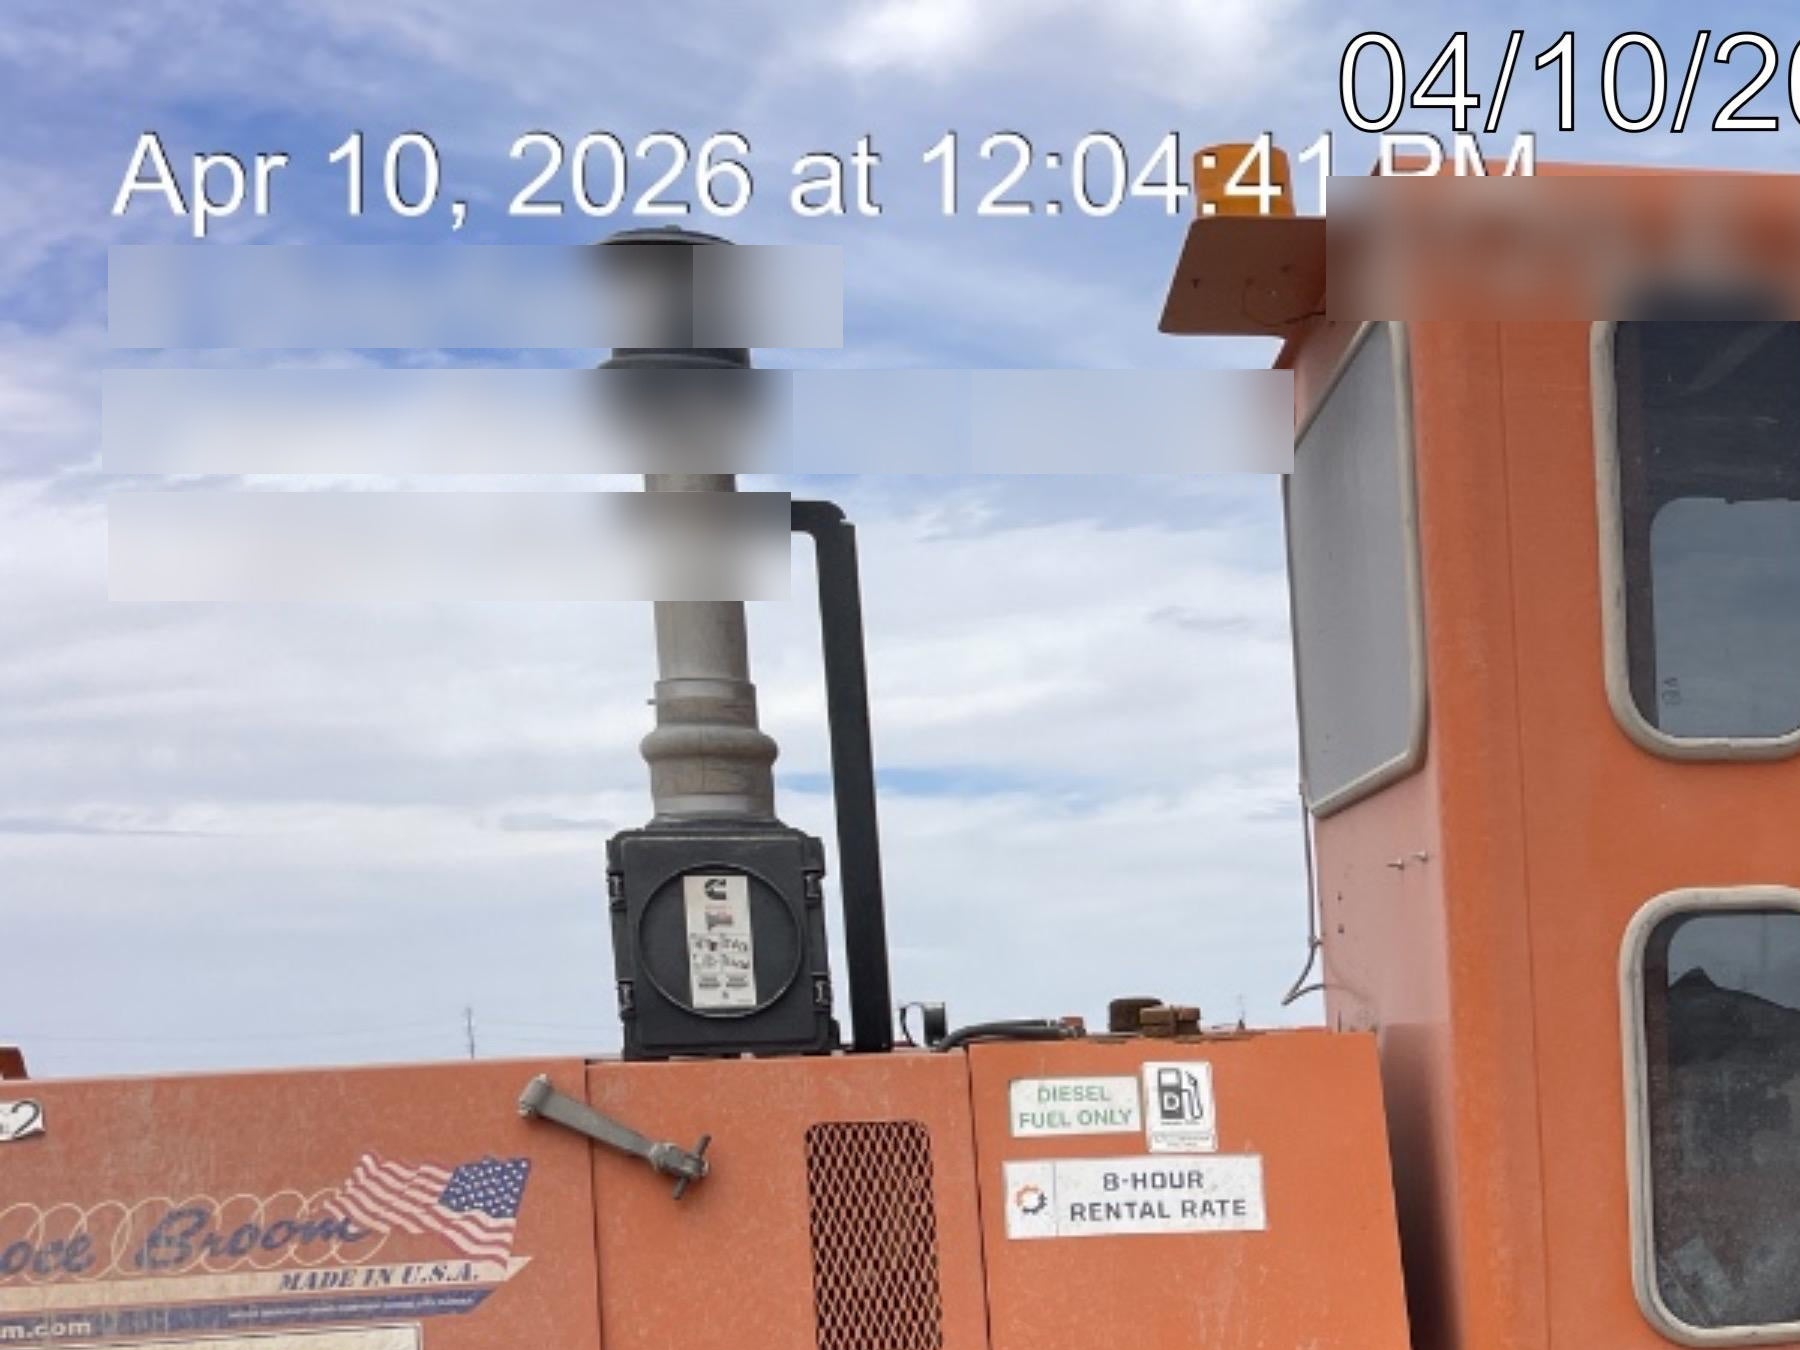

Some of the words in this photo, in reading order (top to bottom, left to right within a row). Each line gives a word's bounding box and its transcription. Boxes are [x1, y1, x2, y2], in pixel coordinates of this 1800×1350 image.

[1037, 1086, 1112, 1103] DIESEL
[1018, 1111, 1072, 1129] FUEL
[1077, 1108, 1133, 1127] ONLY
[1069, 1201, 1171, 1222] RENTAL
[1181, 1199, 1248, 1219] RATE
[134, 1207, 369, 1268] Broom
[279, 1268, 356, 1291] MADE
[363, 1266, 396, 1286] IN
[401, 1263, 480, 1285] U.S.A.
